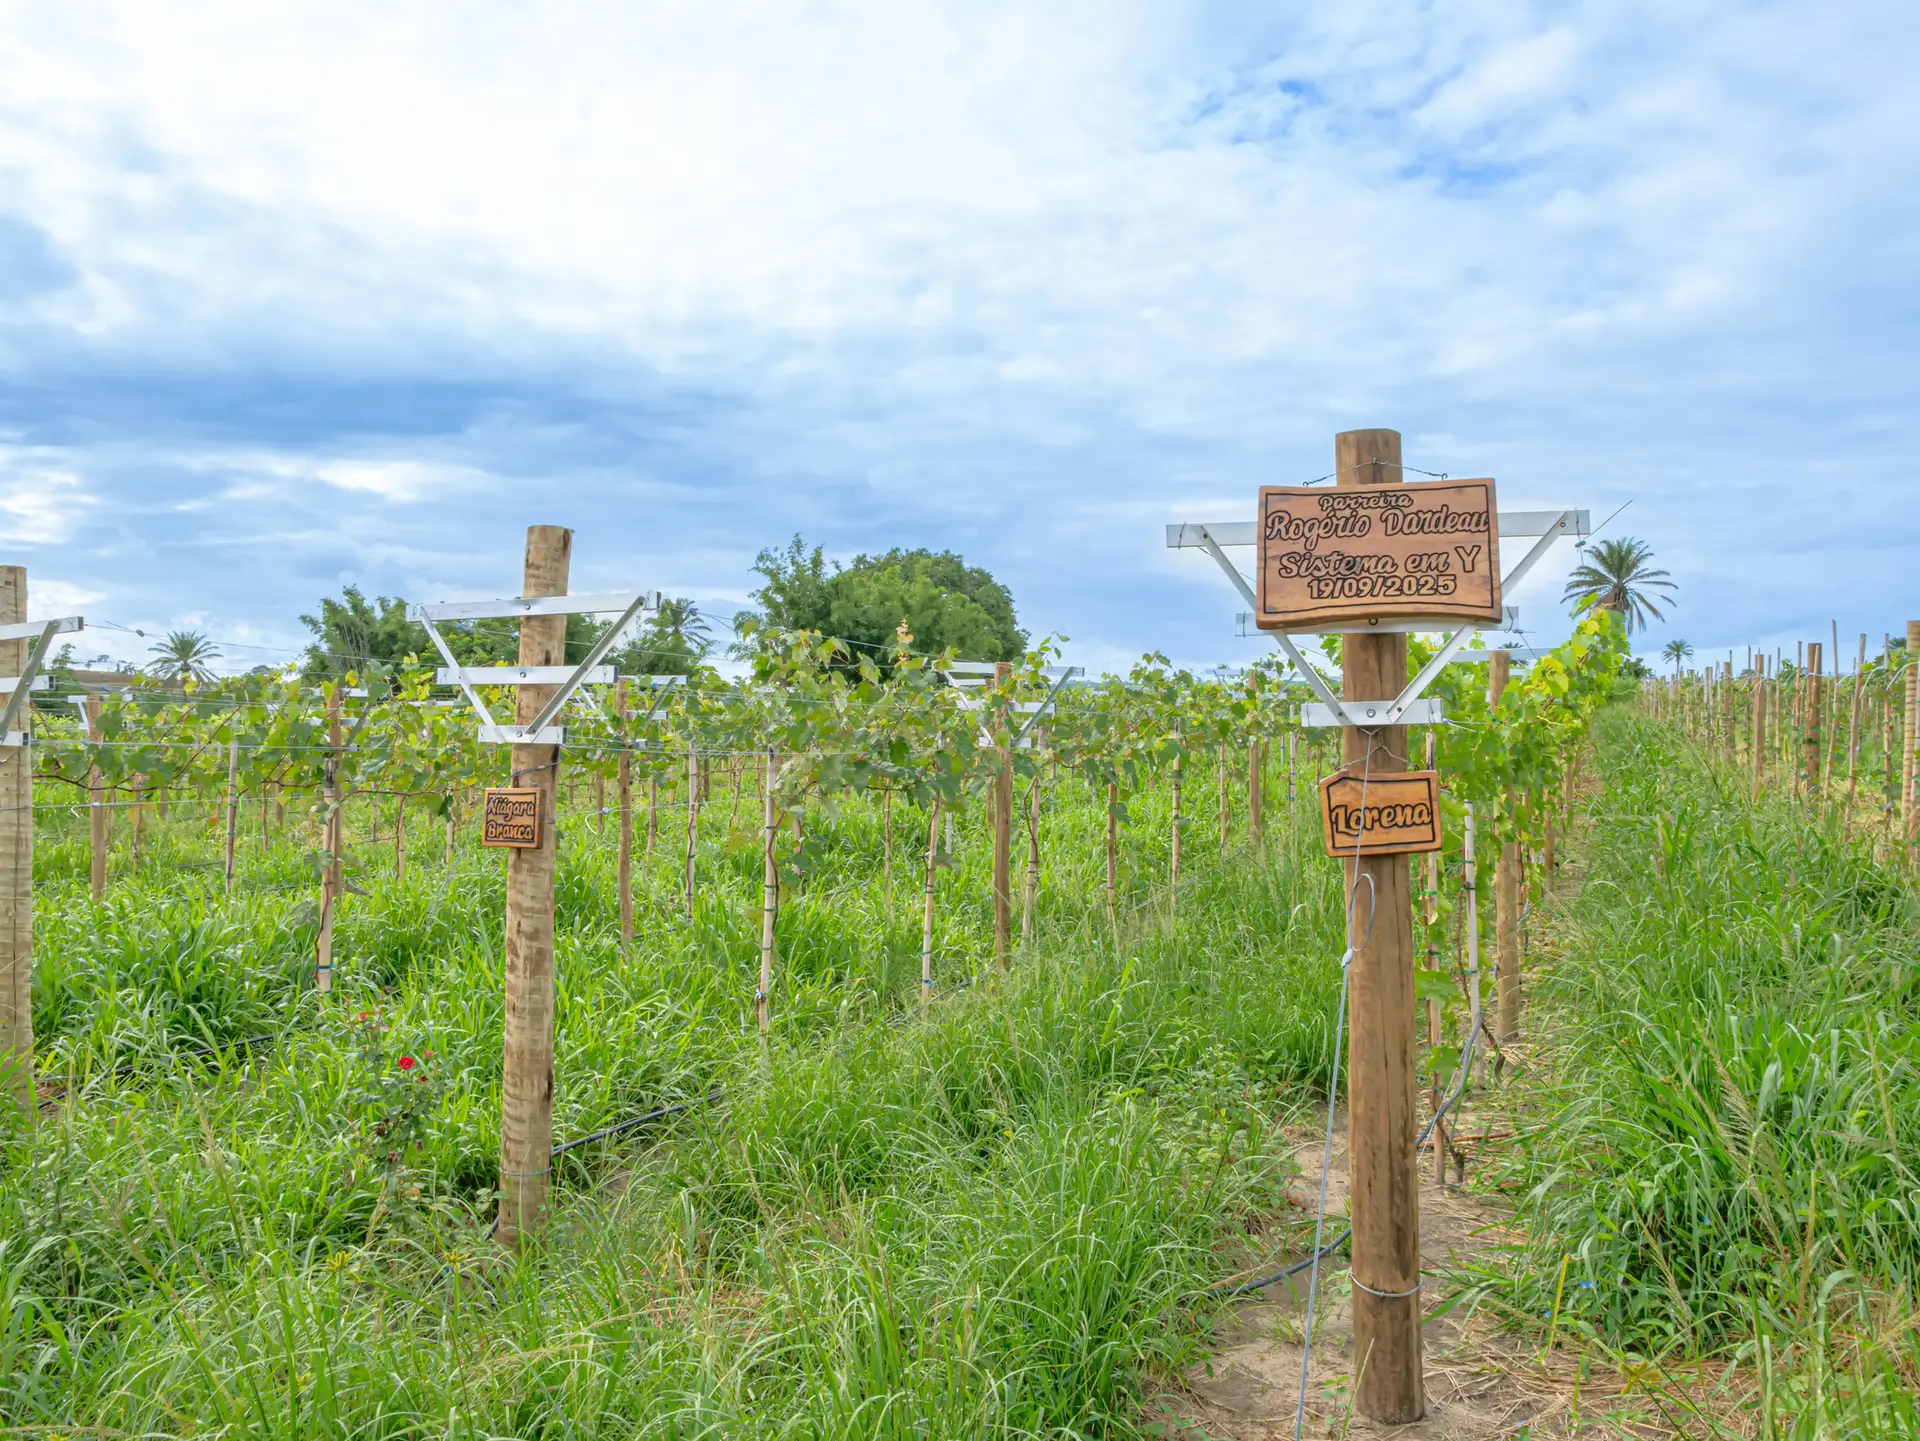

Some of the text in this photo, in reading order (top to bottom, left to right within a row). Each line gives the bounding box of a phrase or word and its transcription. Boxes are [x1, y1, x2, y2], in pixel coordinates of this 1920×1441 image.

[1266, 504, 1489, 550] Rogério Dardeau
[1278, 545, 1482, 579] Sistema em Y
[1307, 574, 1457, 599] 19/09/2025
[486, 819, 535, 840] Branca
[1330, 802, 1432, 837] Lorena
